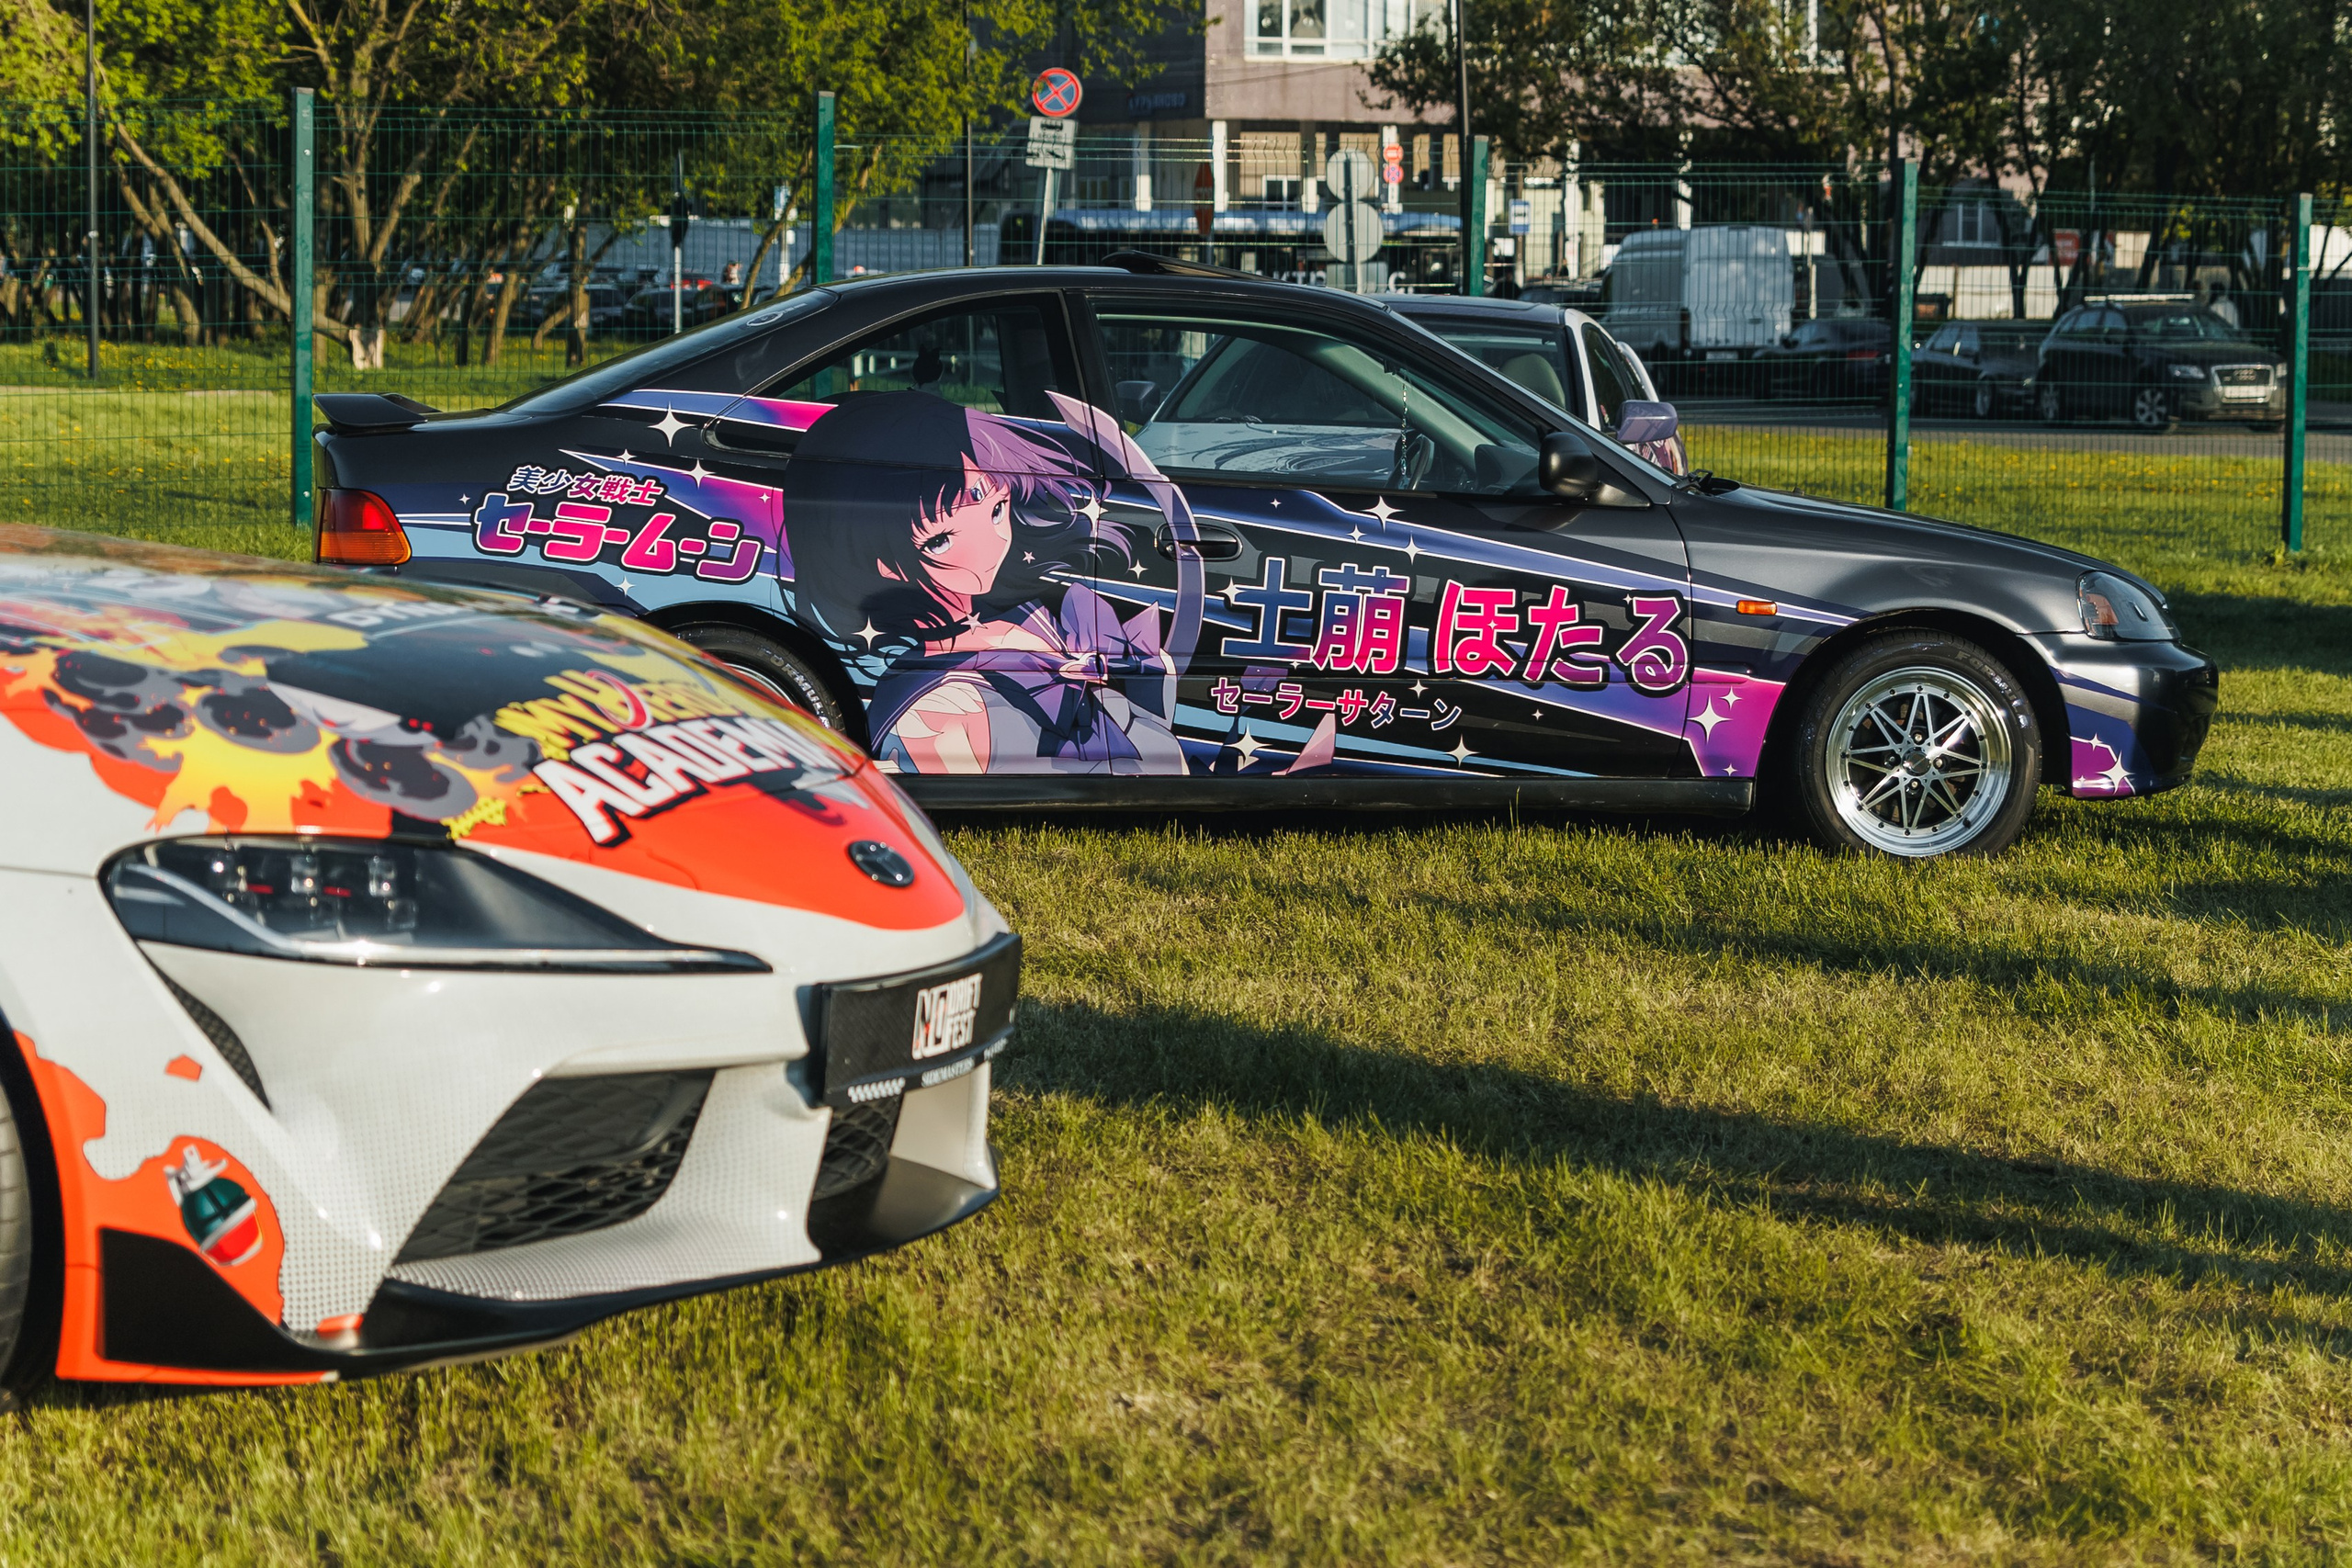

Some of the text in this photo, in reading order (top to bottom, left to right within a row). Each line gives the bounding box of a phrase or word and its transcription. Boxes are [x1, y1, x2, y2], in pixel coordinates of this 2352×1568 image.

[506, 465, 665, 506] 美少女戦士
[474, 493, 761, 581] セーラームーン
[1221, 557, 1689, 690] 土萌 ほたる
[493, 693, 625, 750] MY
[1211, 677, 1462, 731] セーラーサターン
[945, 1009, 977, 1051] FEST
